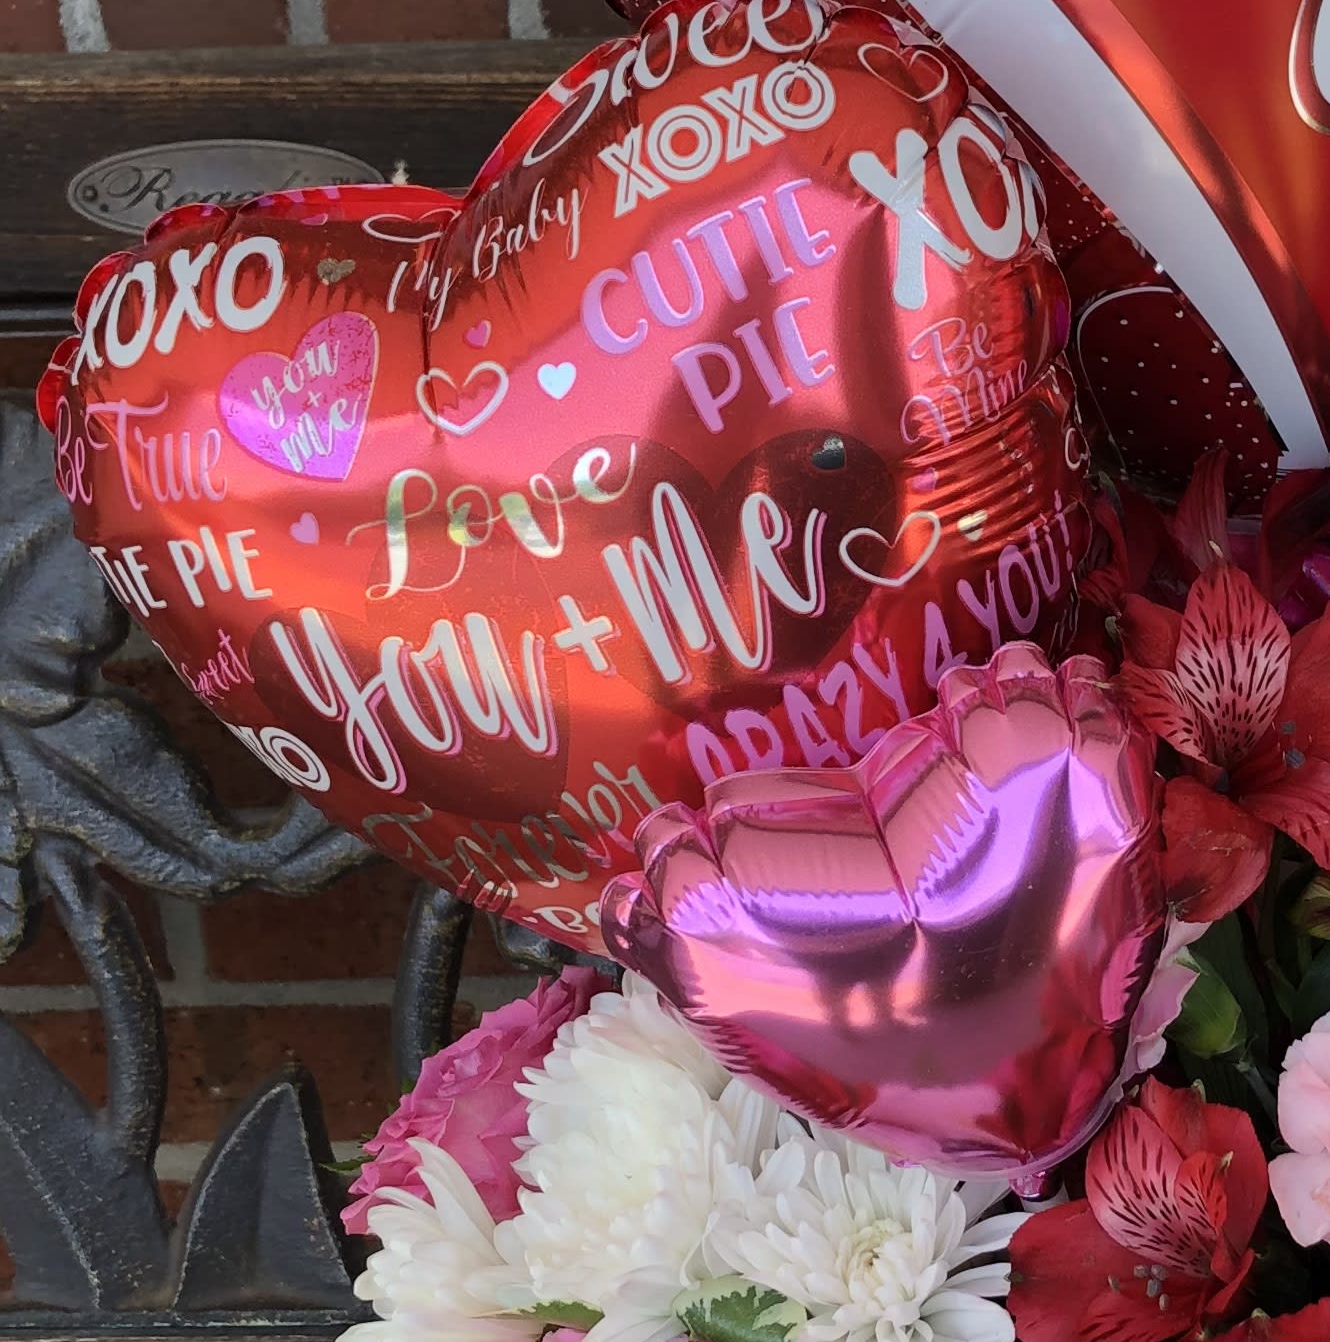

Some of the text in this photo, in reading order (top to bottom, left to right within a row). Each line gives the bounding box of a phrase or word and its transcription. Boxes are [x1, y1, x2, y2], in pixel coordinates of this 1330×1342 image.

[597, 60, 837, 219] XOXO
[472, 178, 591, 280] Baby
[581, 177, 837, 356] CUTIE
[74, 235, 285, 386] XOXO
[671, 297, 836, 433] PIE
[906, 316, 995, 379] Be
[88, 394, 229, 512] True
[167, 525, 274, 609] PIE
[345, 442, 639, 600] Love
[554, 594, 620, 677] +
